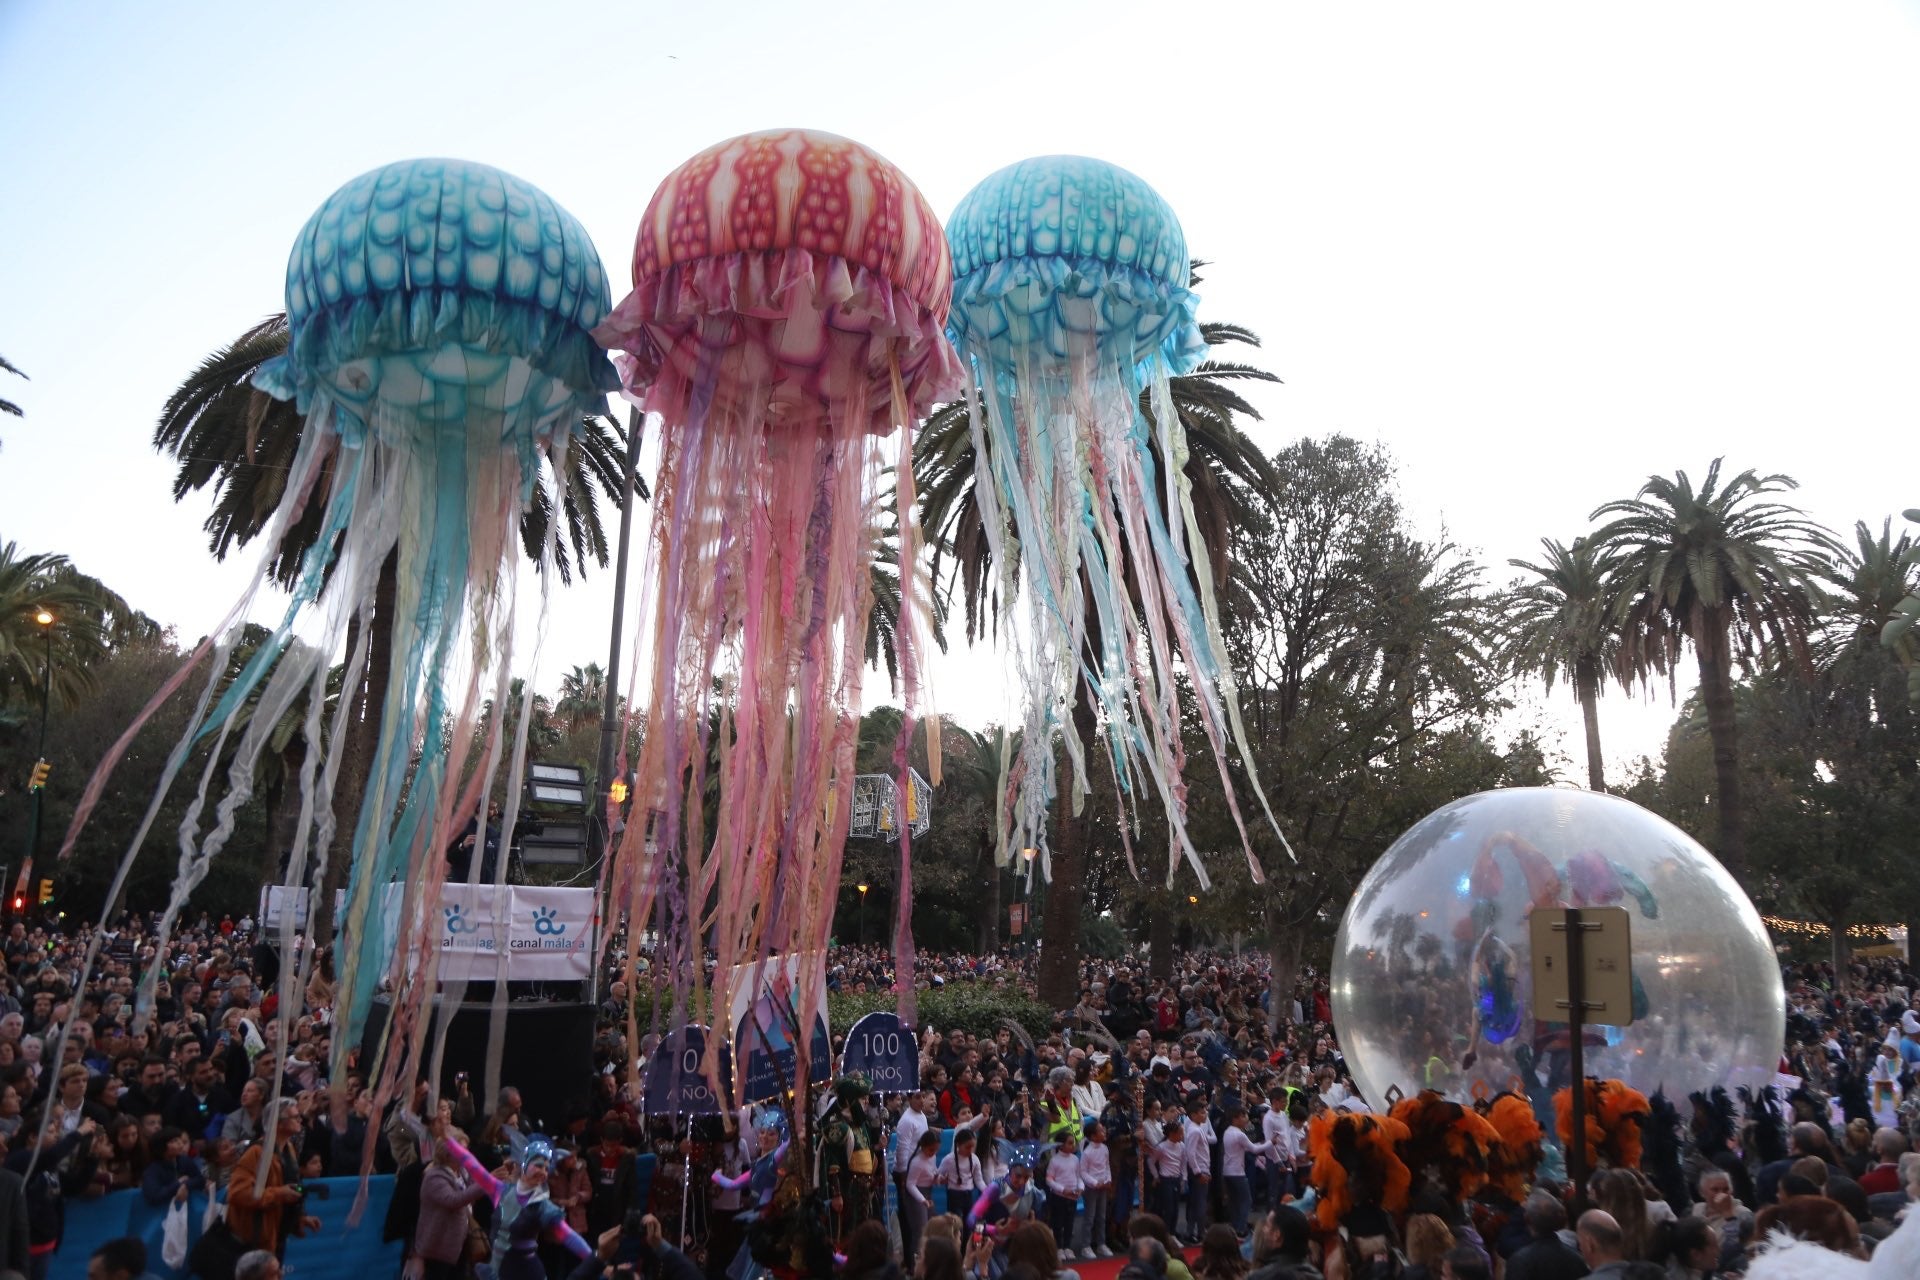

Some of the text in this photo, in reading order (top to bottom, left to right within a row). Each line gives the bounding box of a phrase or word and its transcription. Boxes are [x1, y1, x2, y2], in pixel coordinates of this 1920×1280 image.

[457, 936, 497, 950] málag
[510, 937, 542, 949] canal
[862, 1032, 899, 1057] 100
[866, 1066, 903, 1085] IÑOS
